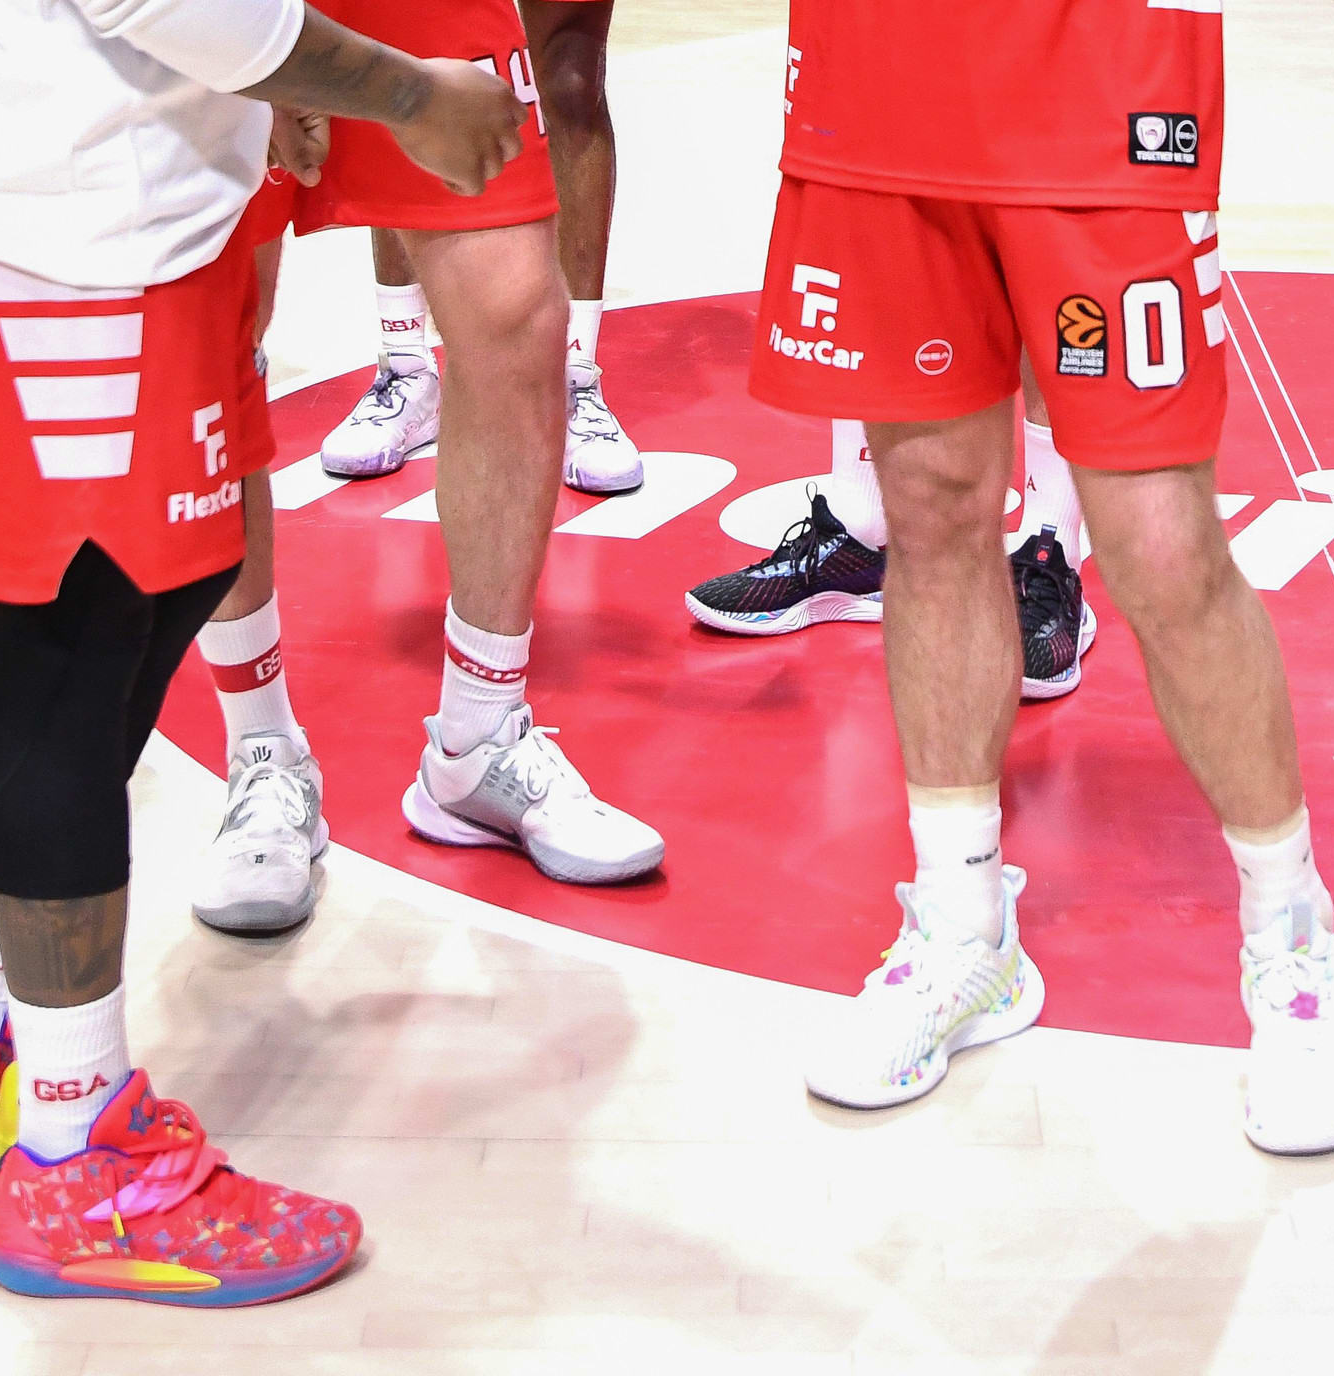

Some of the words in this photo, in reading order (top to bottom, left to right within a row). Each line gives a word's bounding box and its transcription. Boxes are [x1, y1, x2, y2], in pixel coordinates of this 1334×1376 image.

[381, 317, 421, 333] GSA
[1121, 278, 1188, 391] 0
[168, 477, 243, 524] FlexCa
[33, 1073, 112, 1104] GSA
